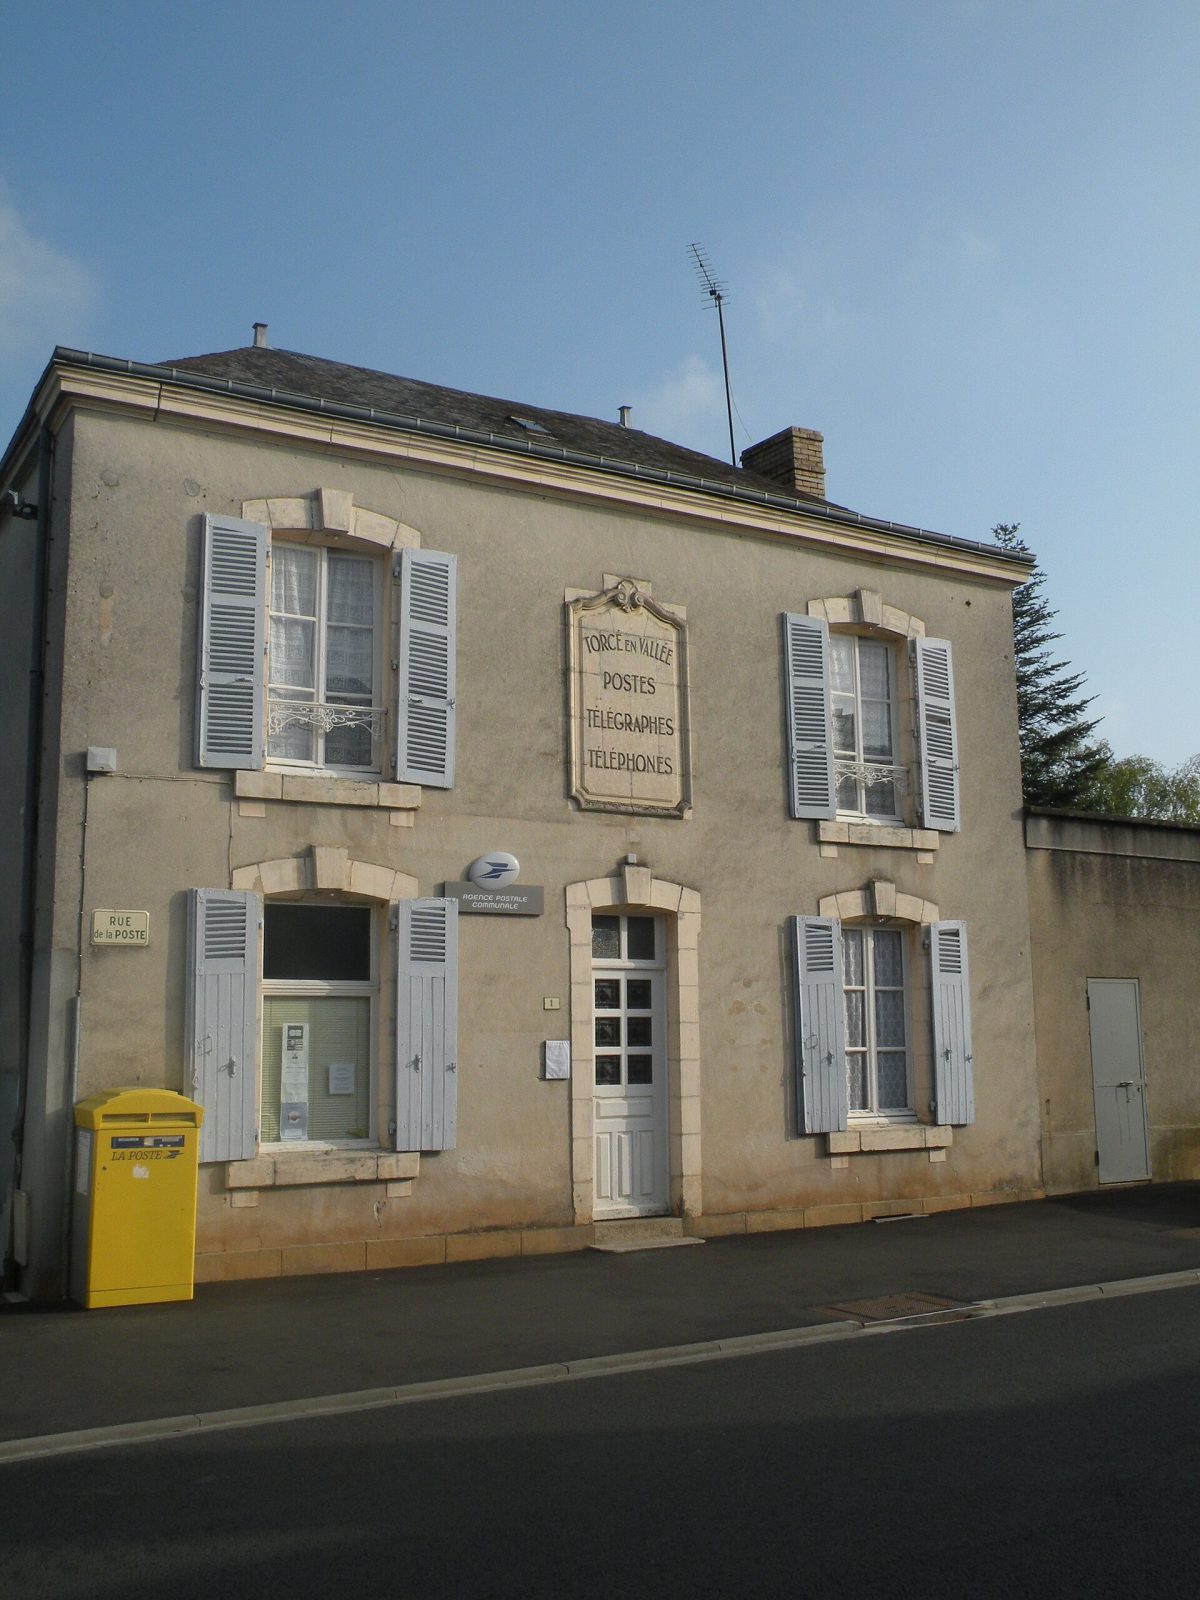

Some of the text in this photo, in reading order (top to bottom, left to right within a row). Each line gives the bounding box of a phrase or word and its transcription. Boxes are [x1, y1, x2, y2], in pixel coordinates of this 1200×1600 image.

[624, 639, 637, 653] EN
[639, 637, 673, 666] VALLÉE
[603, 671, 656, 695] POSTES
[586, 705, 674, 736] TÉLÉGRAPHES
[587, 746, 673, 775] TÉLÉPHONES
[462, 893, 528, 903] AGENCE POSTALE
[472, 901, 518, 910] COMMUNALE
[109, 916, 132, 926] RUE
[94, 929, 146, 940] de la POSTE
[111, 1150, 162, 1161] LA POSTE
